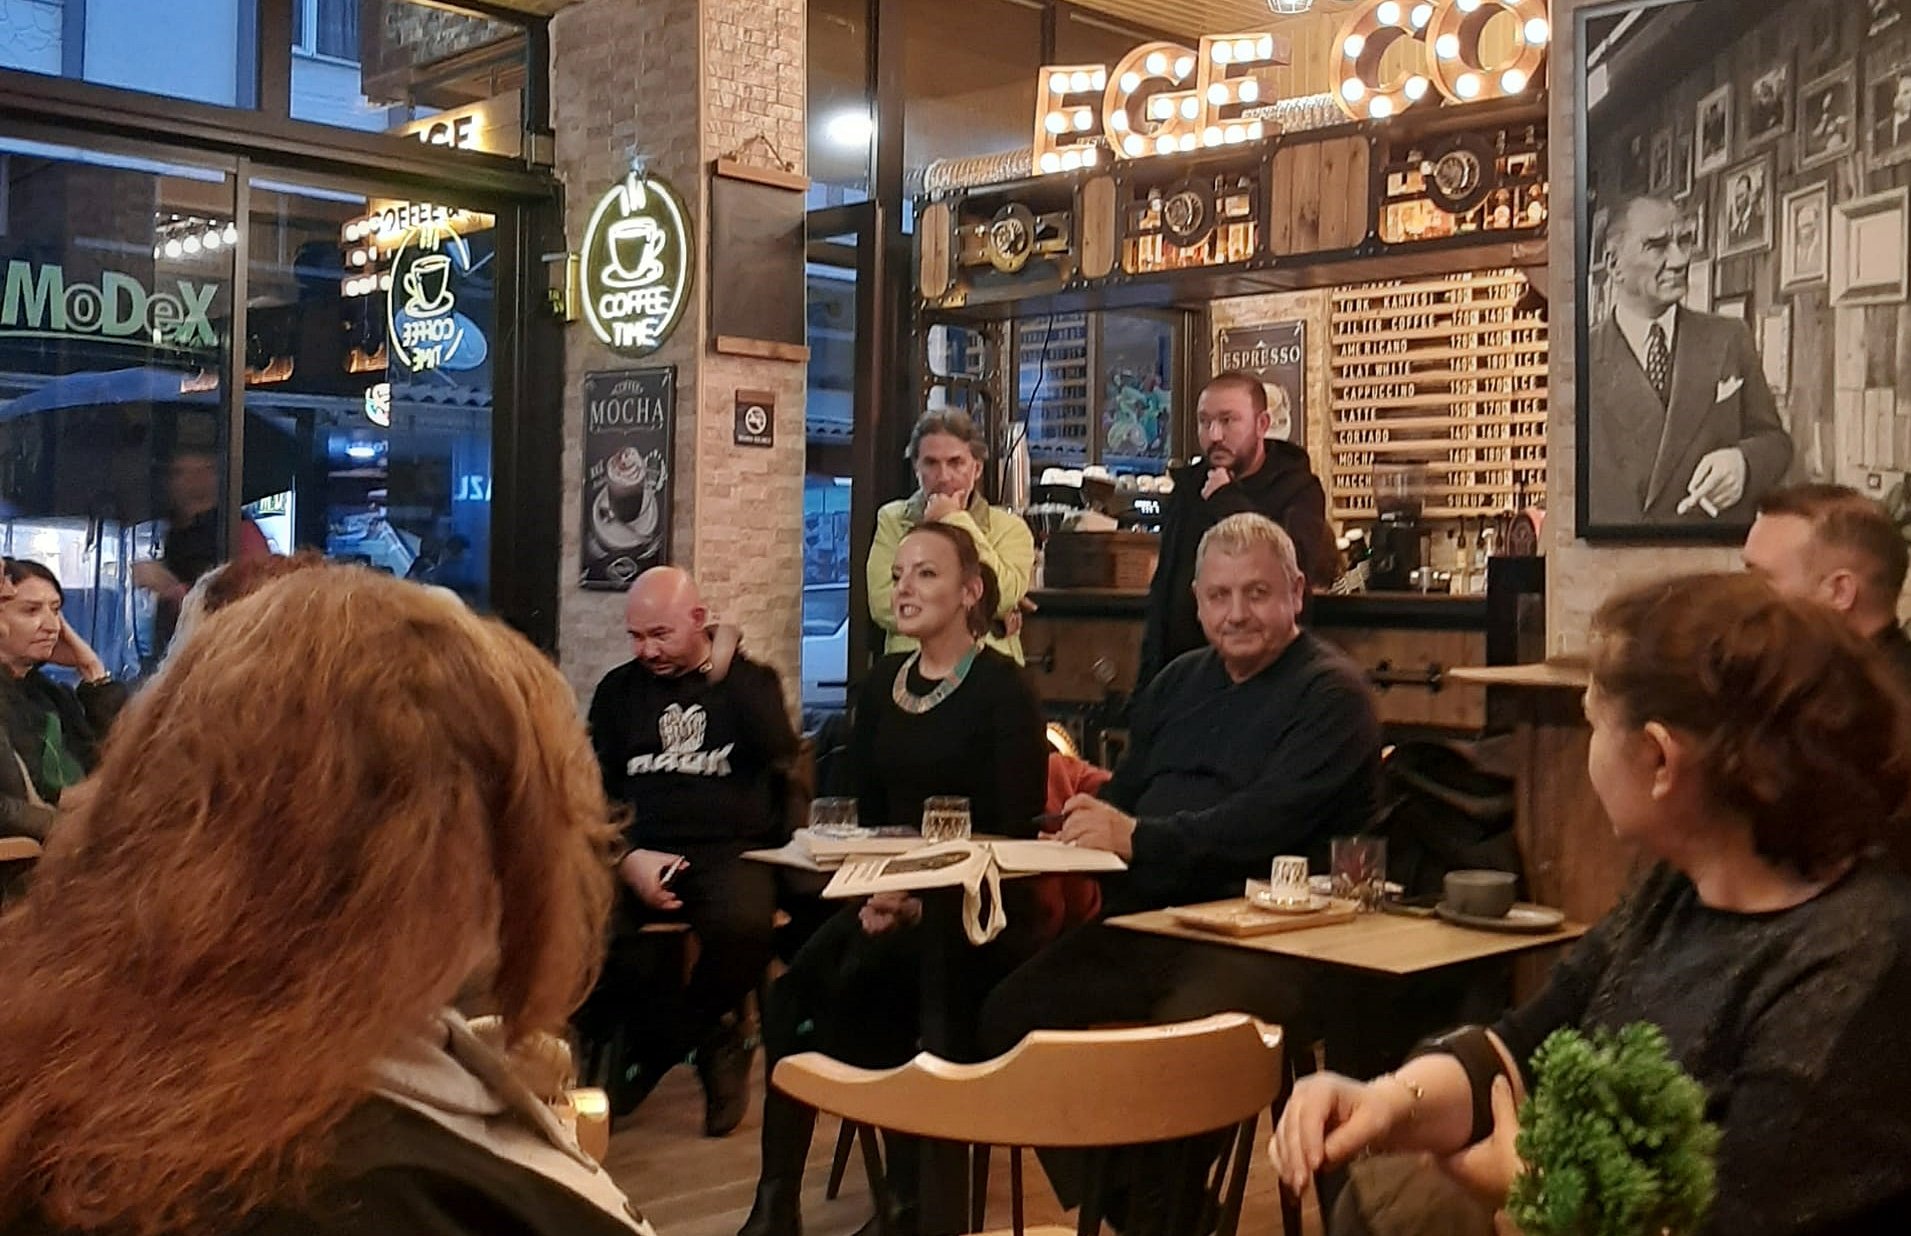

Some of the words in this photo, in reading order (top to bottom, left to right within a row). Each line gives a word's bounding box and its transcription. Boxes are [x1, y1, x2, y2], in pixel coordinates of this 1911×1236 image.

[1032, 33, 1278, 176] EGE
[599, 285, 671, 318] COFFEE
[612, 317, 659, 347] TIME
[1340, 319, 1382, 335] FILTER
[1392, 314, 1435, 331] COFFEE
[1341, 339, 1408, 357] AMERICANO
[1516, 327, 1537, 343] ICE
[1223, 345, 1300, 371] ESPRESSO
[1342, 363, 1370, 379] FLAT
[1375, 360, 1411, 377] WHITE
[1518, 352, 1540, 367] ICE
[1343, 382, 1415, 400] CAPPUCCINO
[1514, 376, 1536, 391] ICE
[590, 397, 664, 425] MOCHA
[1341, 407, 1376, 422] LATTE
[1518, 398, 1538, 413] ICE
[1340, 428, 1389, 444] CORTADO
[1516, 422, 1536, 437] ICE
[1520, 445, 1541, 460] ICE
